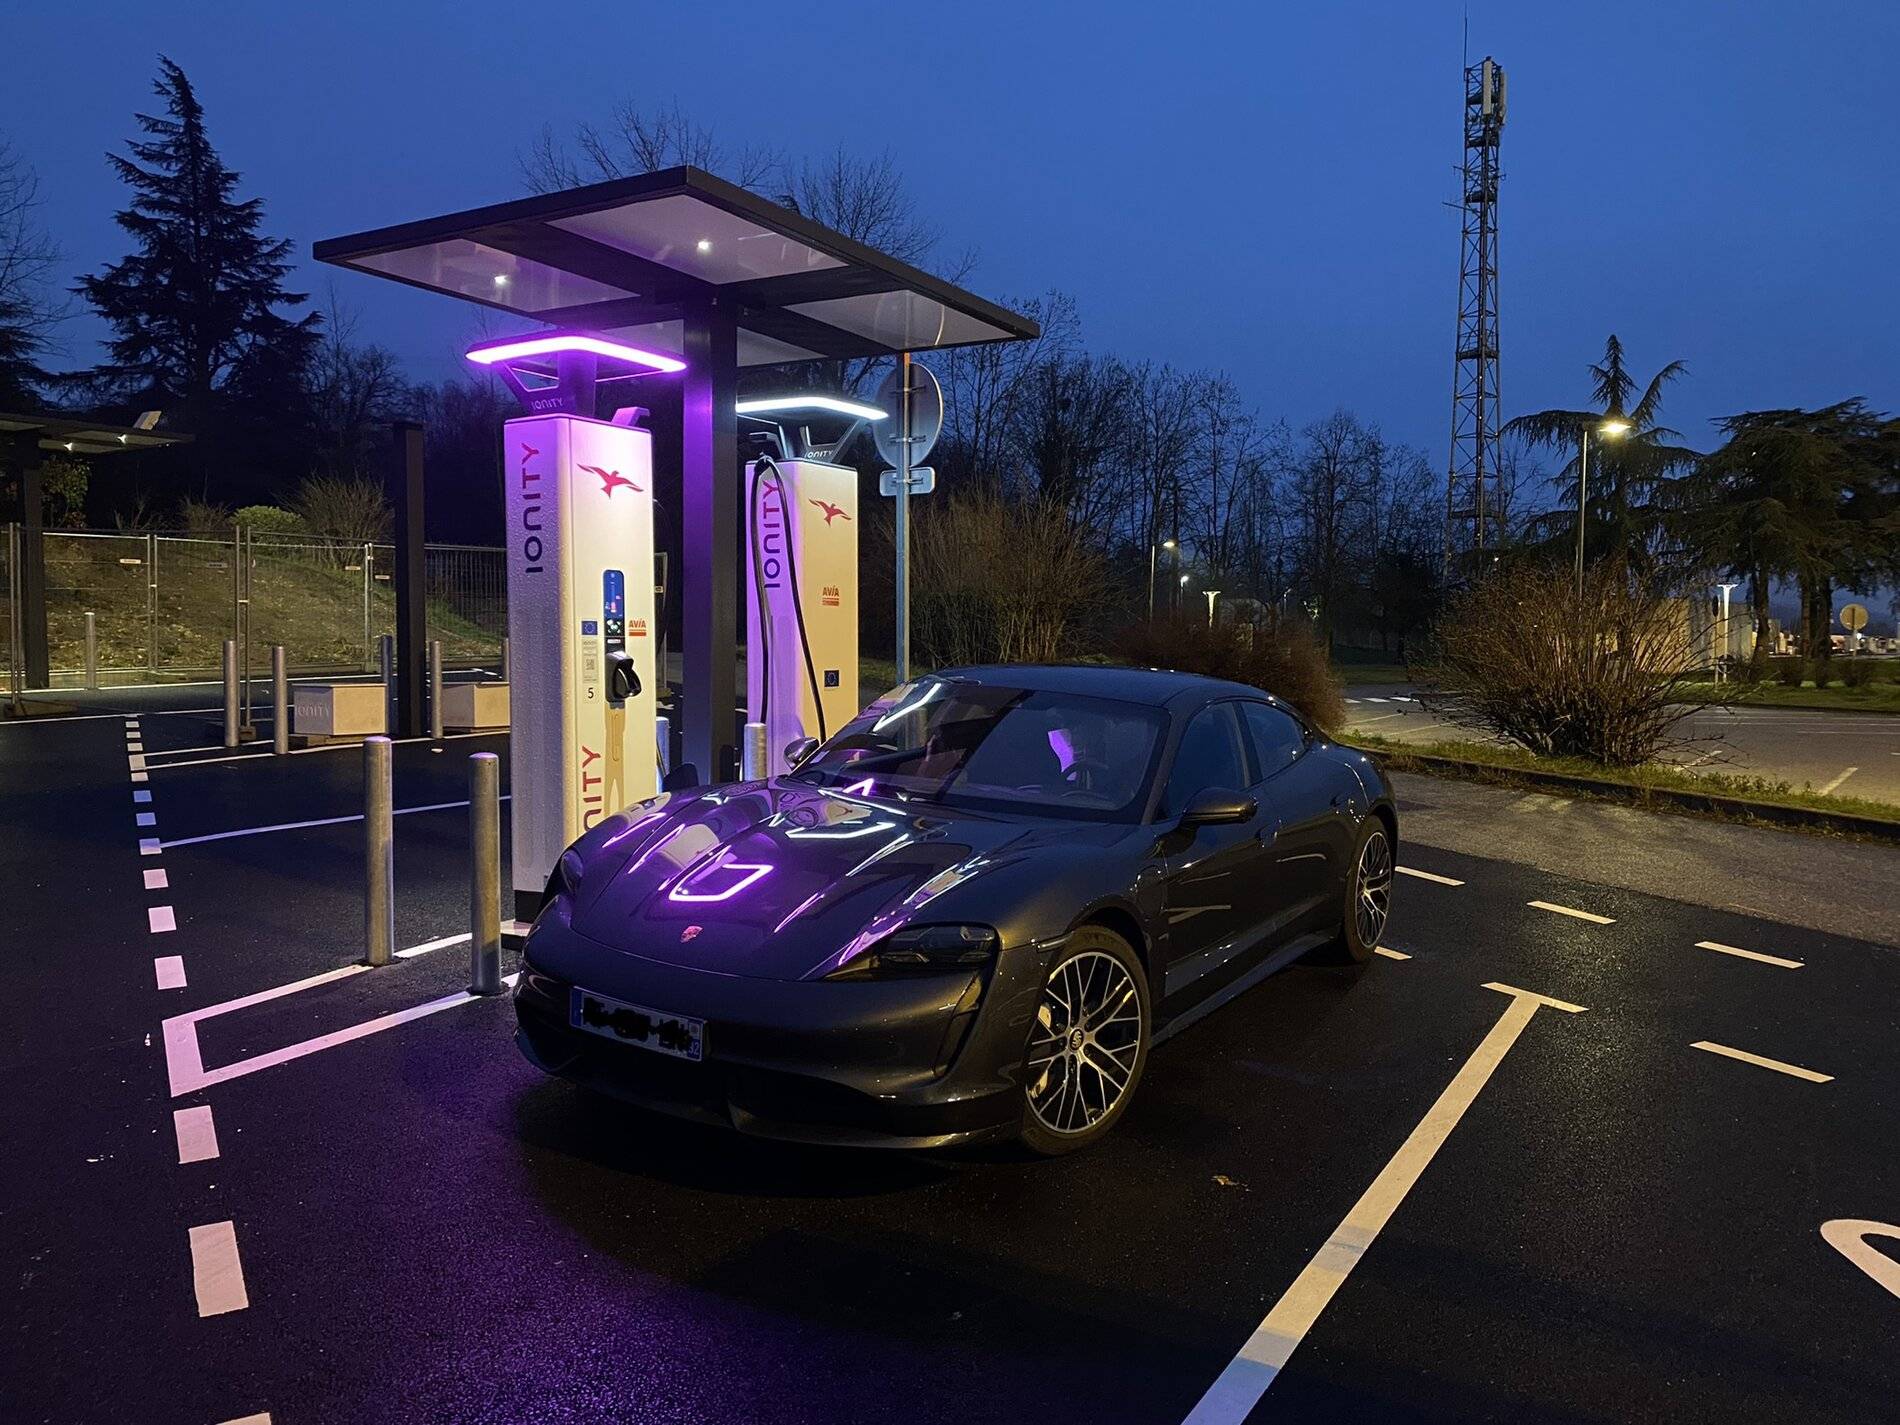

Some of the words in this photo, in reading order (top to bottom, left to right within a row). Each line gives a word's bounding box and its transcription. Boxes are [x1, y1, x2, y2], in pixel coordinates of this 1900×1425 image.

[521, 443, 543, 573] IONITY
[763, 480, 780, 588] IONITY
[587, 687, 594, 699] 5
[581, 745, 602, 832] NITY
